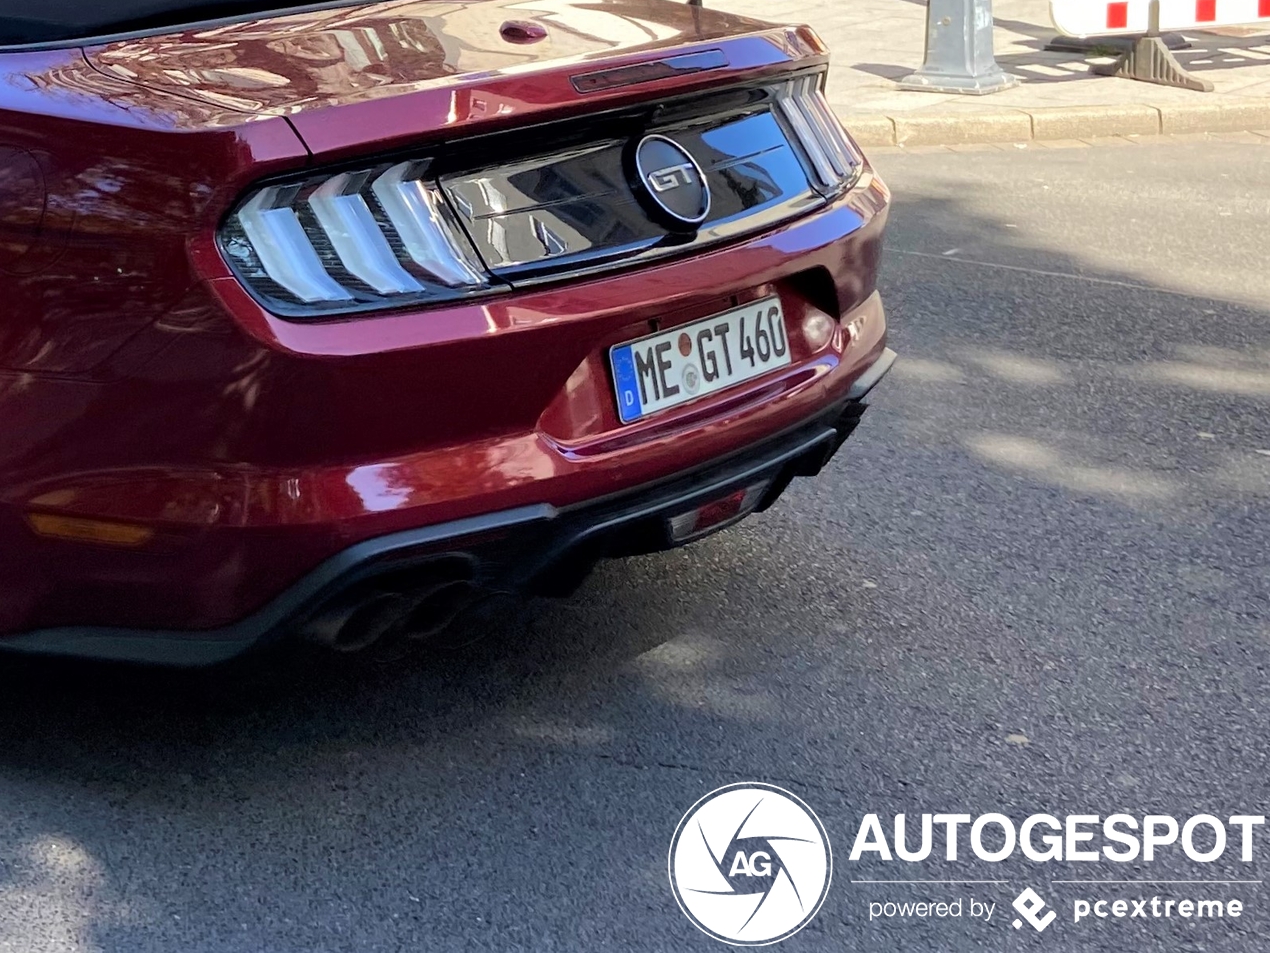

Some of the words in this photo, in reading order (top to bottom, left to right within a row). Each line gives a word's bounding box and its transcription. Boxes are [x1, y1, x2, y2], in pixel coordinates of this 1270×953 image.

[648, 162, 693, 192] GT
[625, 389, 634, 407] D
[634, 341, 680, 406] ME
[697, 322, 733, 383] GT
[739, 305, 787, 368] 460
